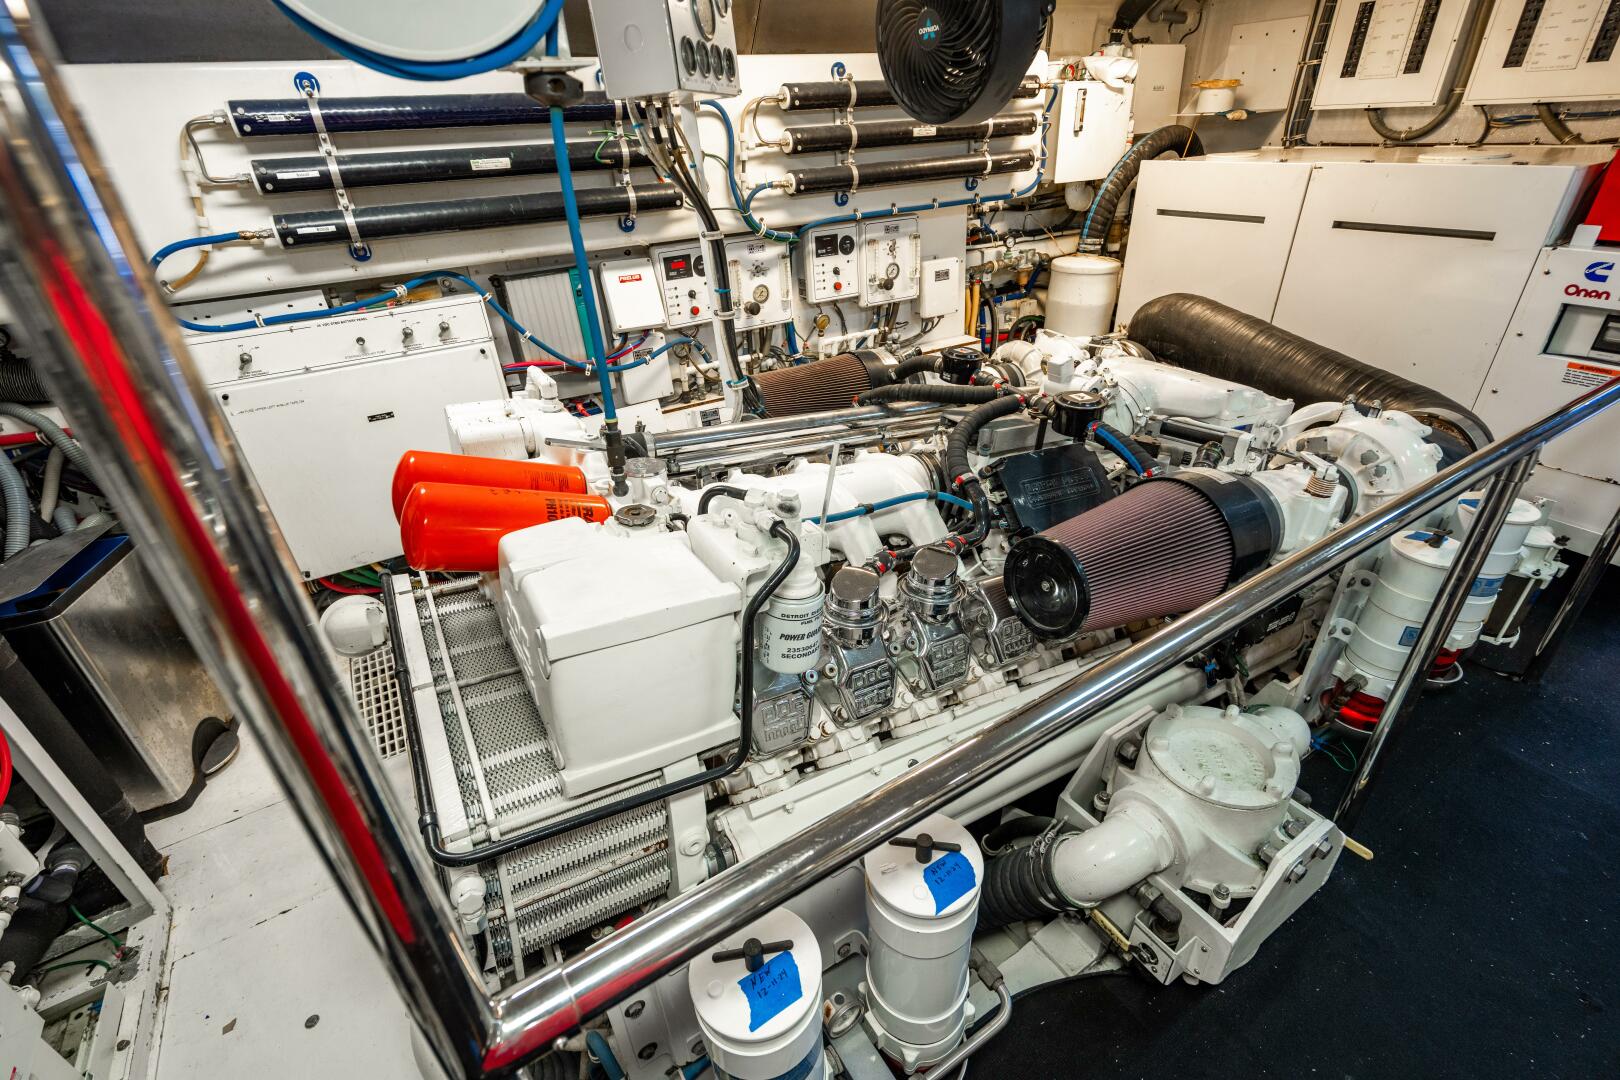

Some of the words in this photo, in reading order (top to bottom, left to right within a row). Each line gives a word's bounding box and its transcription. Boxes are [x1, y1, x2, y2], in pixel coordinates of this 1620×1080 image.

[1564, 284, 1611, 301] Onan
[779, 633, 806, 641] POWER
[930, 860, 946, 876] NEW
[750, 964, 772, 990] NEW
